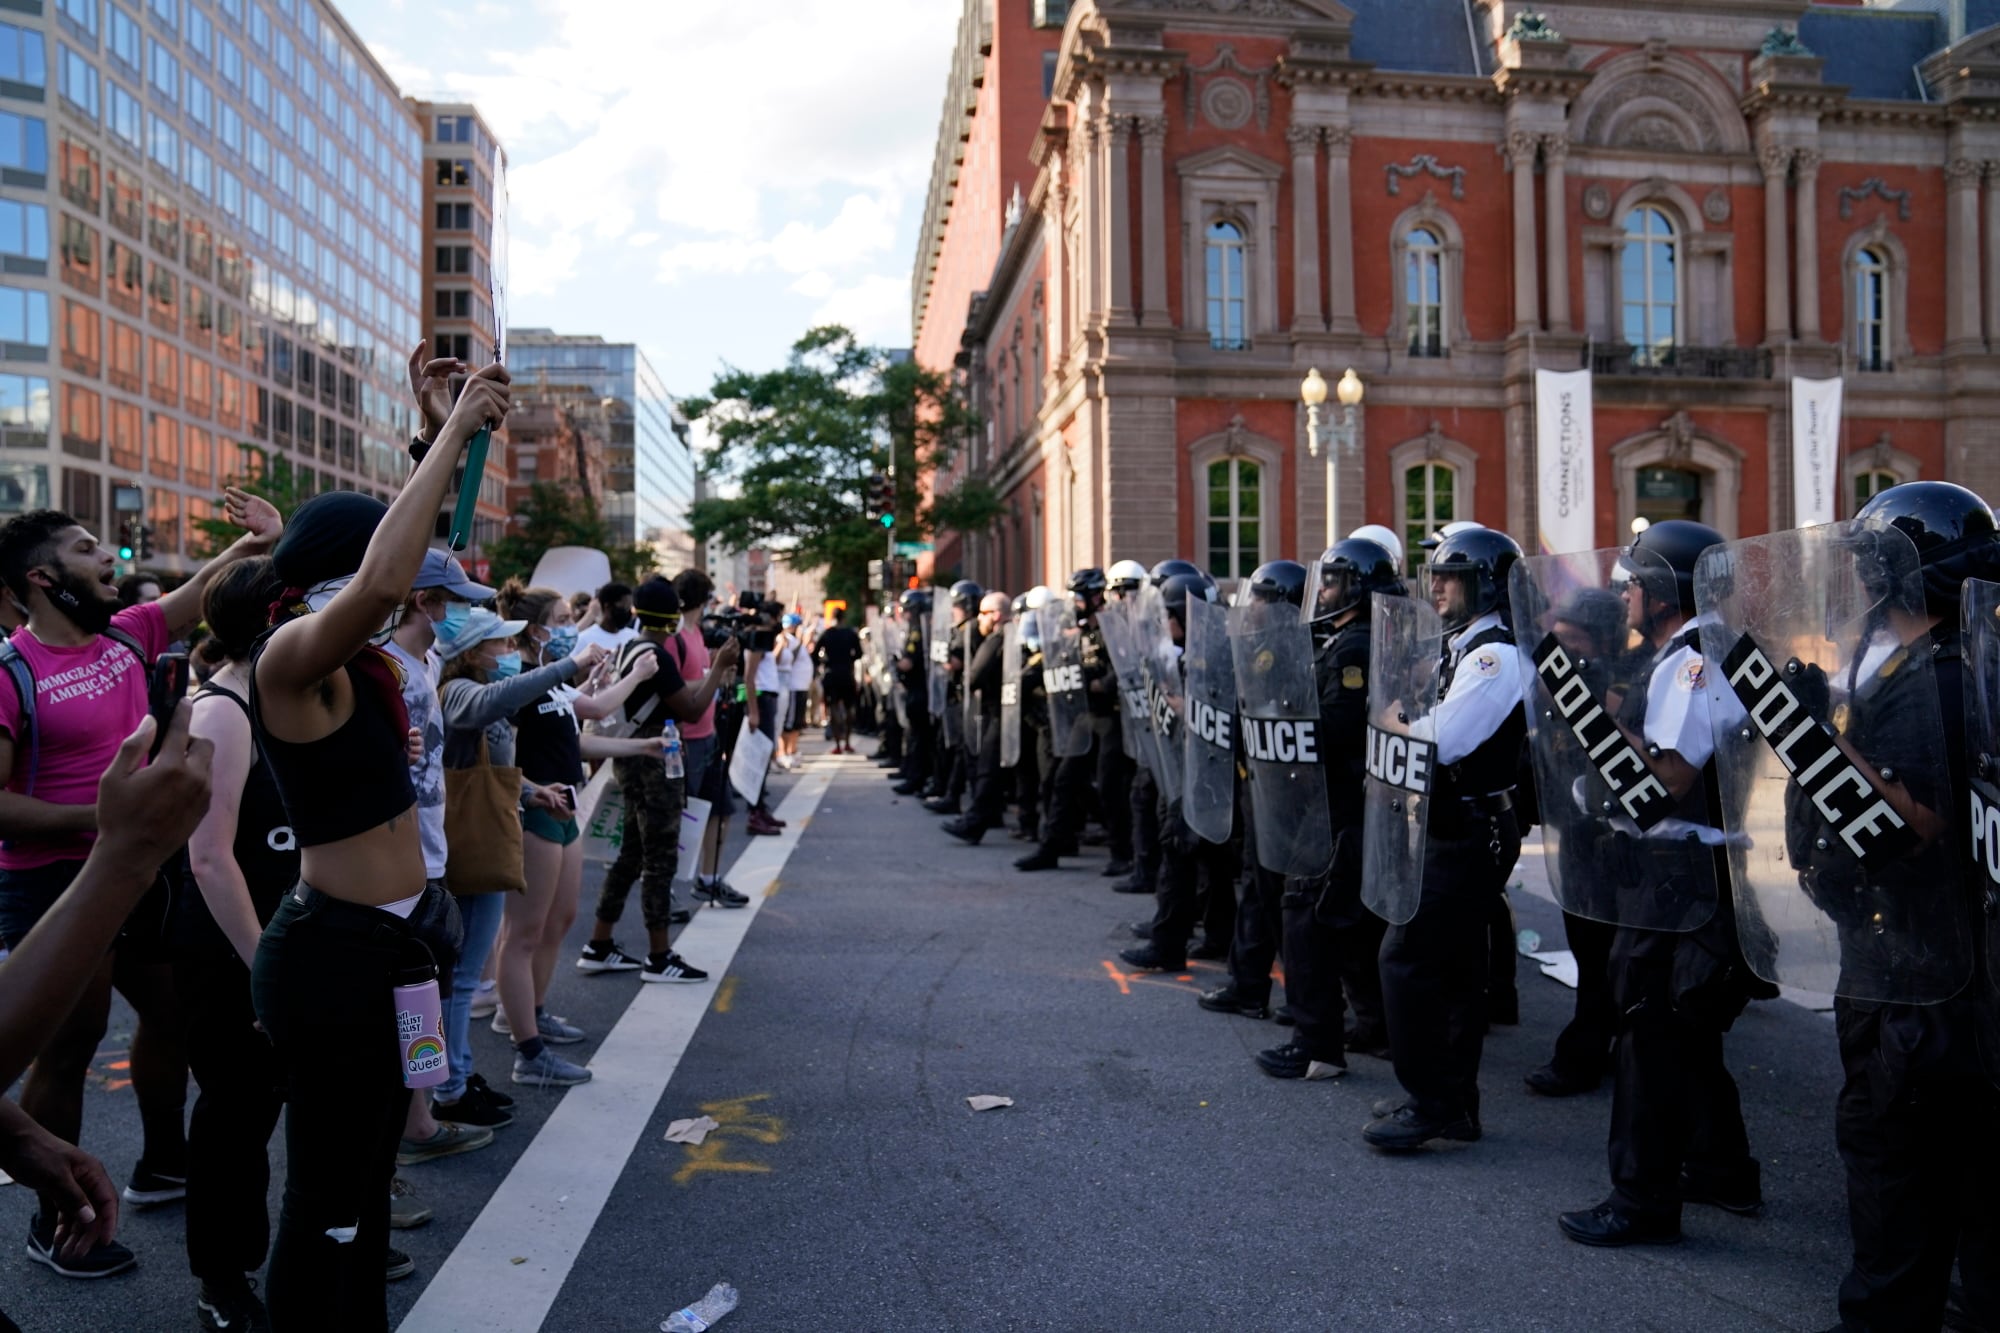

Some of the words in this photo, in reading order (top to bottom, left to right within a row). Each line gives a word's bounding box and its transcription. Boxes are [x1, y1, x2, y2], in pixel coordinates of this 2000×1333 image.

[1558, 391, 1572, 519] CONNECTIONS
[50, 673, 109, 704] AMERICA
[1538, 645, 1668, 819] POLICE
[1729, 647, 1906, 858] POLICE
